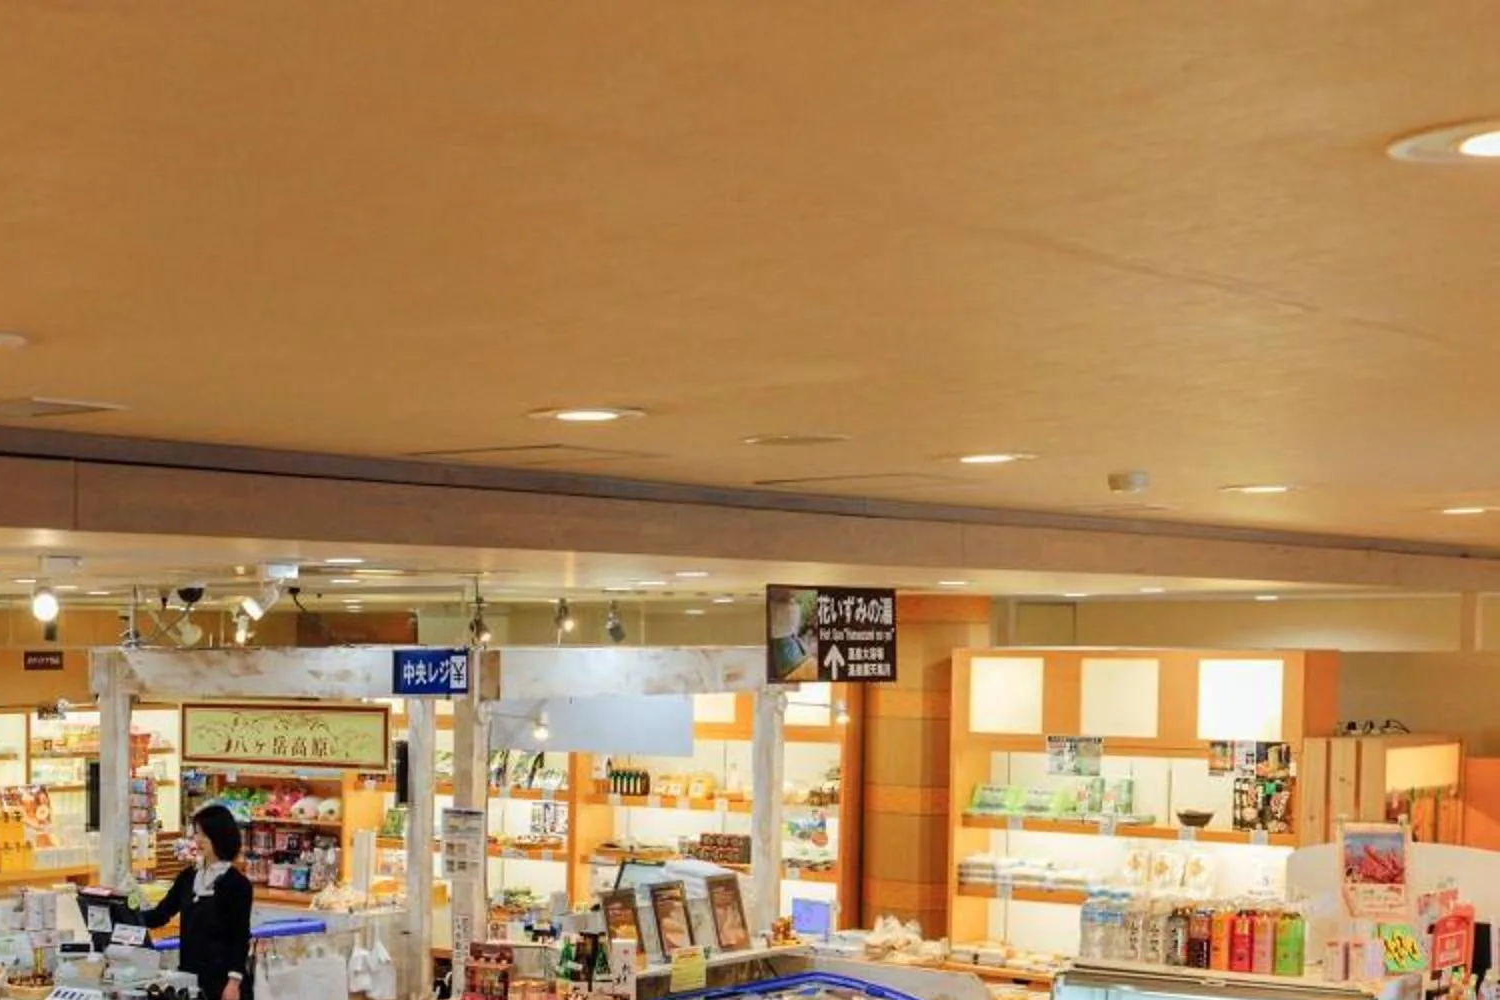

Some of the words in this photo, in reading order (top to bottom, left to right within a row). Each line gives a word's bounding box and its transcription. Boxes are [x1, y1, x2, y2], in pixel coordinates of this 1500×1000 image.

[818, 595, 893, 625] 花いずみの湯
[402, 660, 450, 686] 中央レジ
